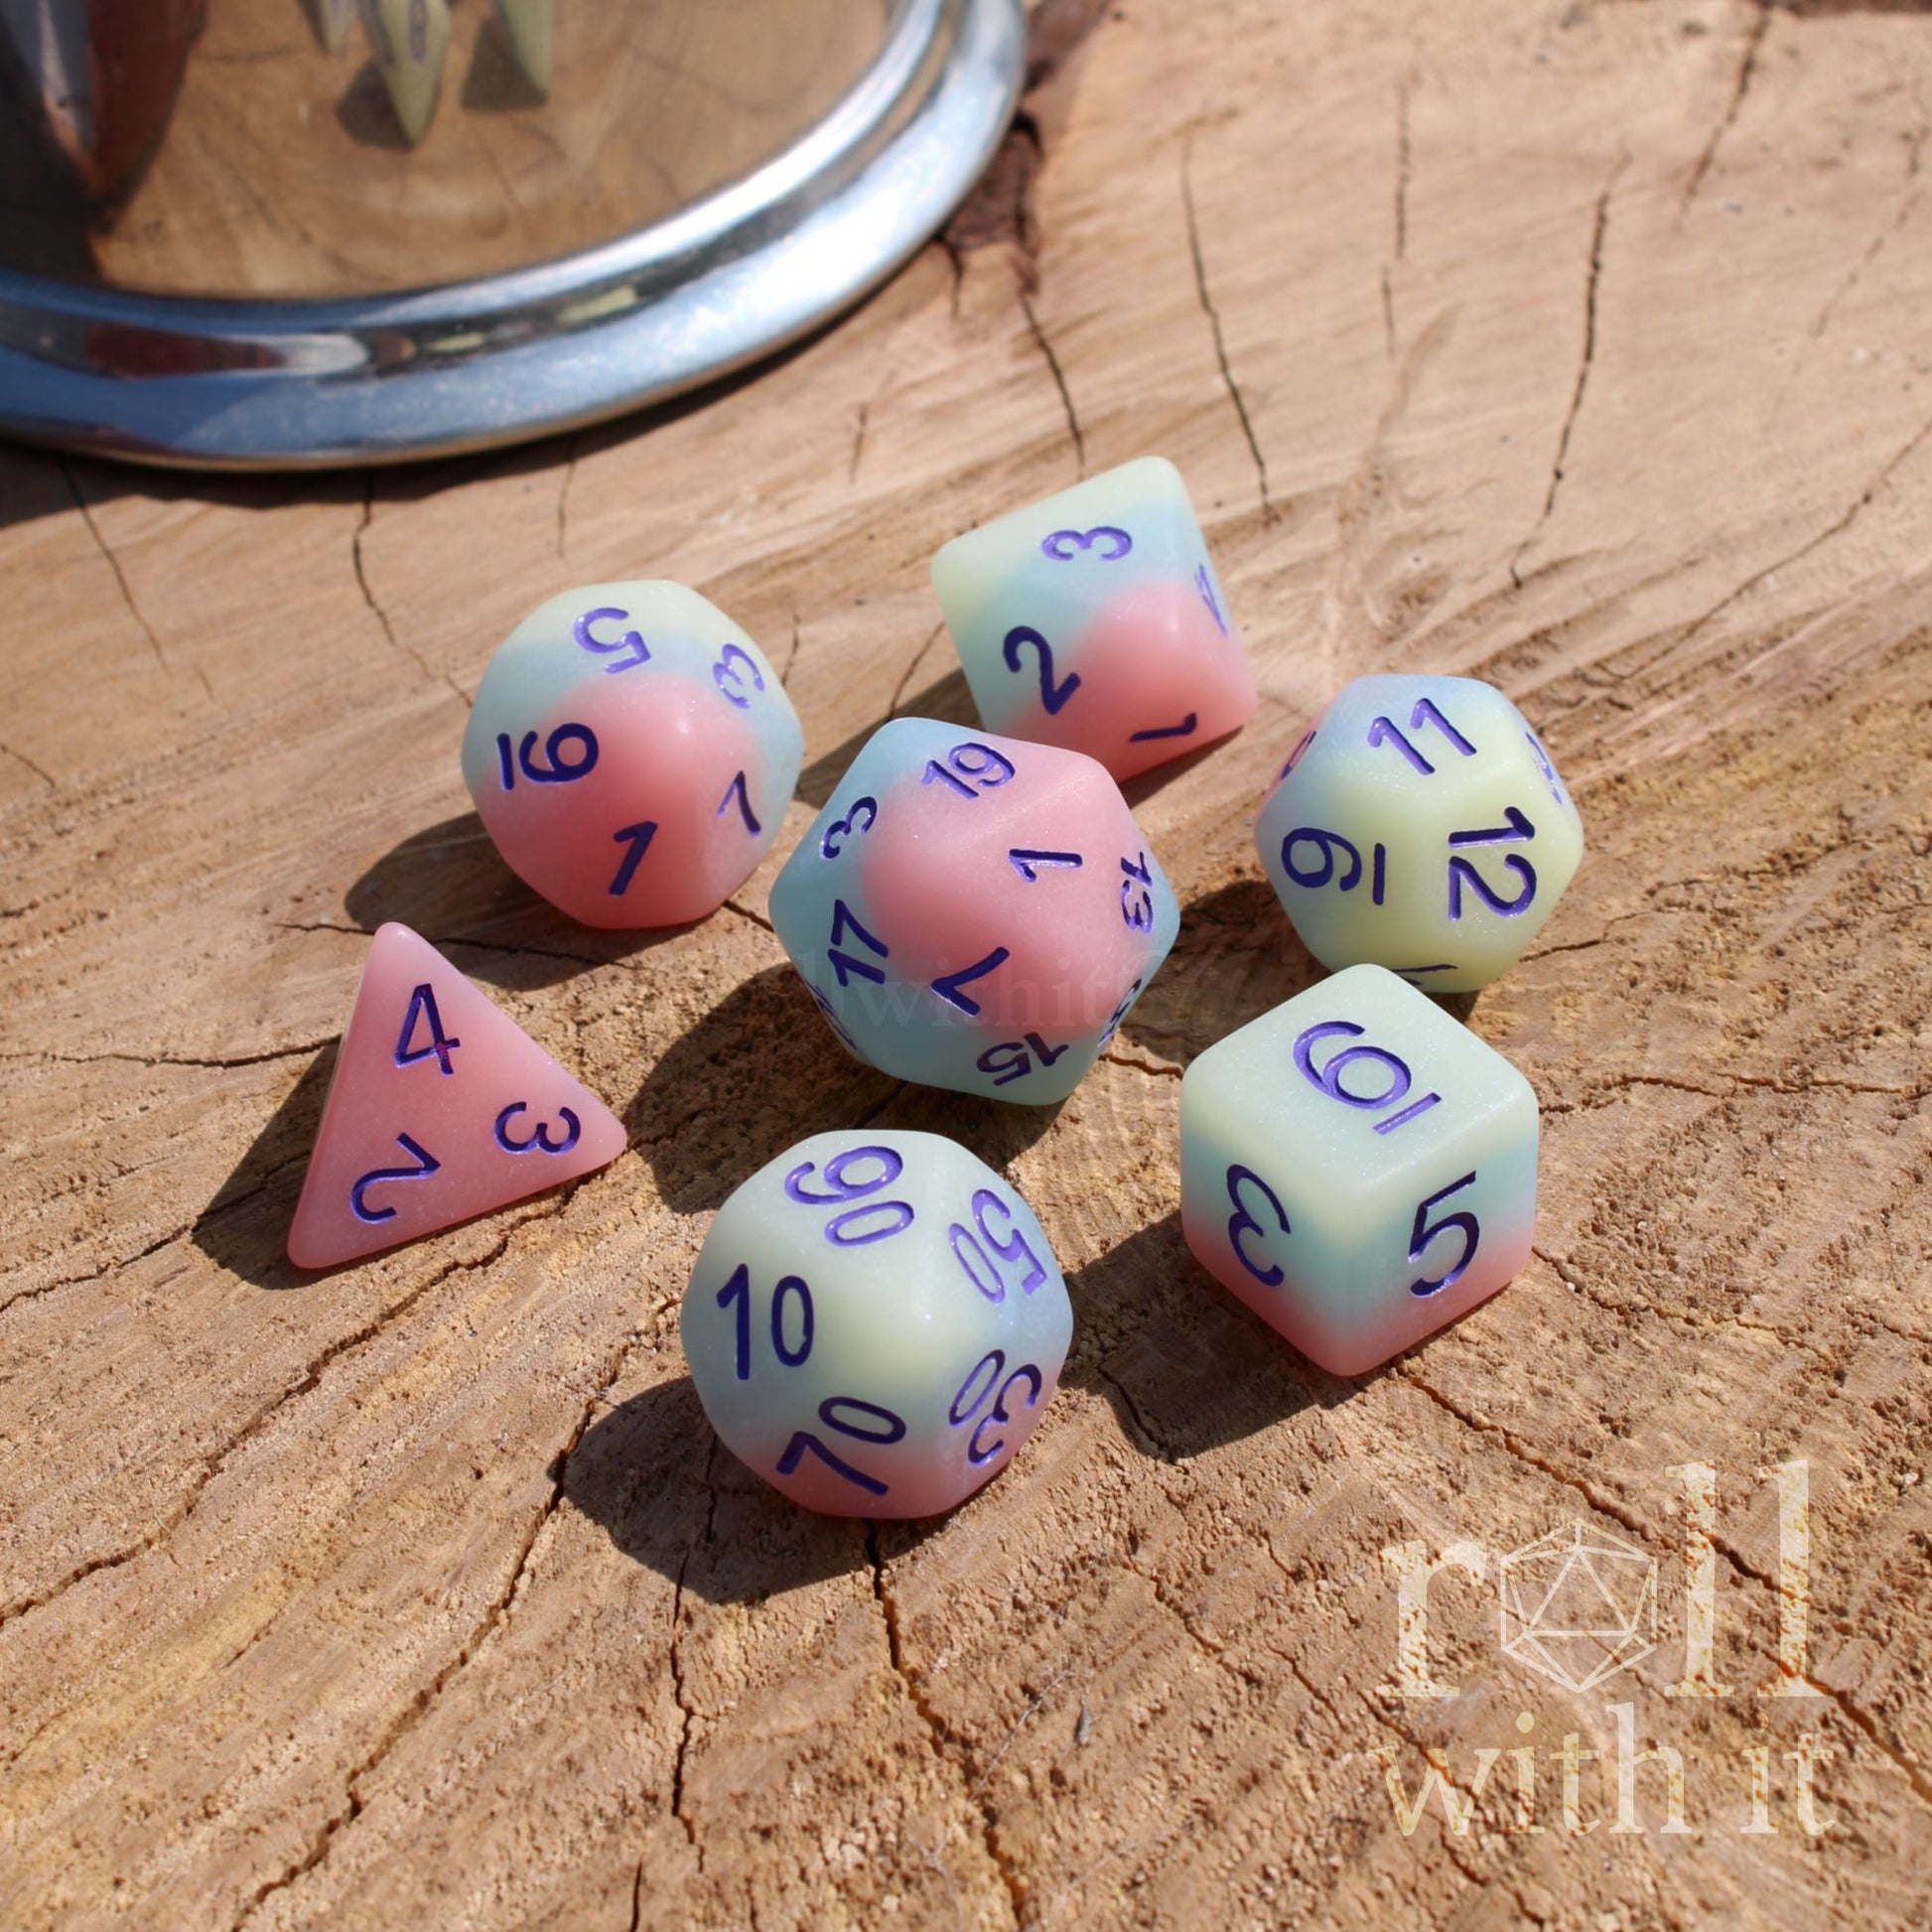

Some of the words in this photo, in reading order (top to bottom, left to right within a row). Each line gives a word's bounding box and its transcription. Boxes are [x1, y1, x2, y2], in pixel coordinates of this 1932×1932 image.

[1040, 526, 1134, 562] 3
[573, 608, 651, 674] 5
[713, 643, 765, 710] 3
[1003, 625, 1082, 717] 2
[1129, 712, 1198, 744] 1
[1367, 698, 1477, 776] 11
[921, 743, 1017, 799] 19
[613, 821, 658, 897] 1
[819, 796, 879, 860] 3
[1009, 848, 1083, 884] 1
[1449, 806, 1538, 922] 12
[1121, 852, 1154, 933] 13
[827, 898, 890, 987] 17
[930, 946, 1011, 1018] 7
[394, 983, 462, 1078] 4
[976, 1033, 1069, 1086] 15
[1293, 1021, 1443, 1136] 6
[494, 1101, 582, 1156] 3
[351, 1133, 442, 1224] 2
[948, 1188, 1048, 1306] 50
[1226, 1164, 1292, 1288] 3
[1408, 1170, 1481, 1300] 5
[716, 1263, 815, 1381] 10
[776, 1396, 907, 1497] 70
[948, 1348, 1043, 1468] 30
